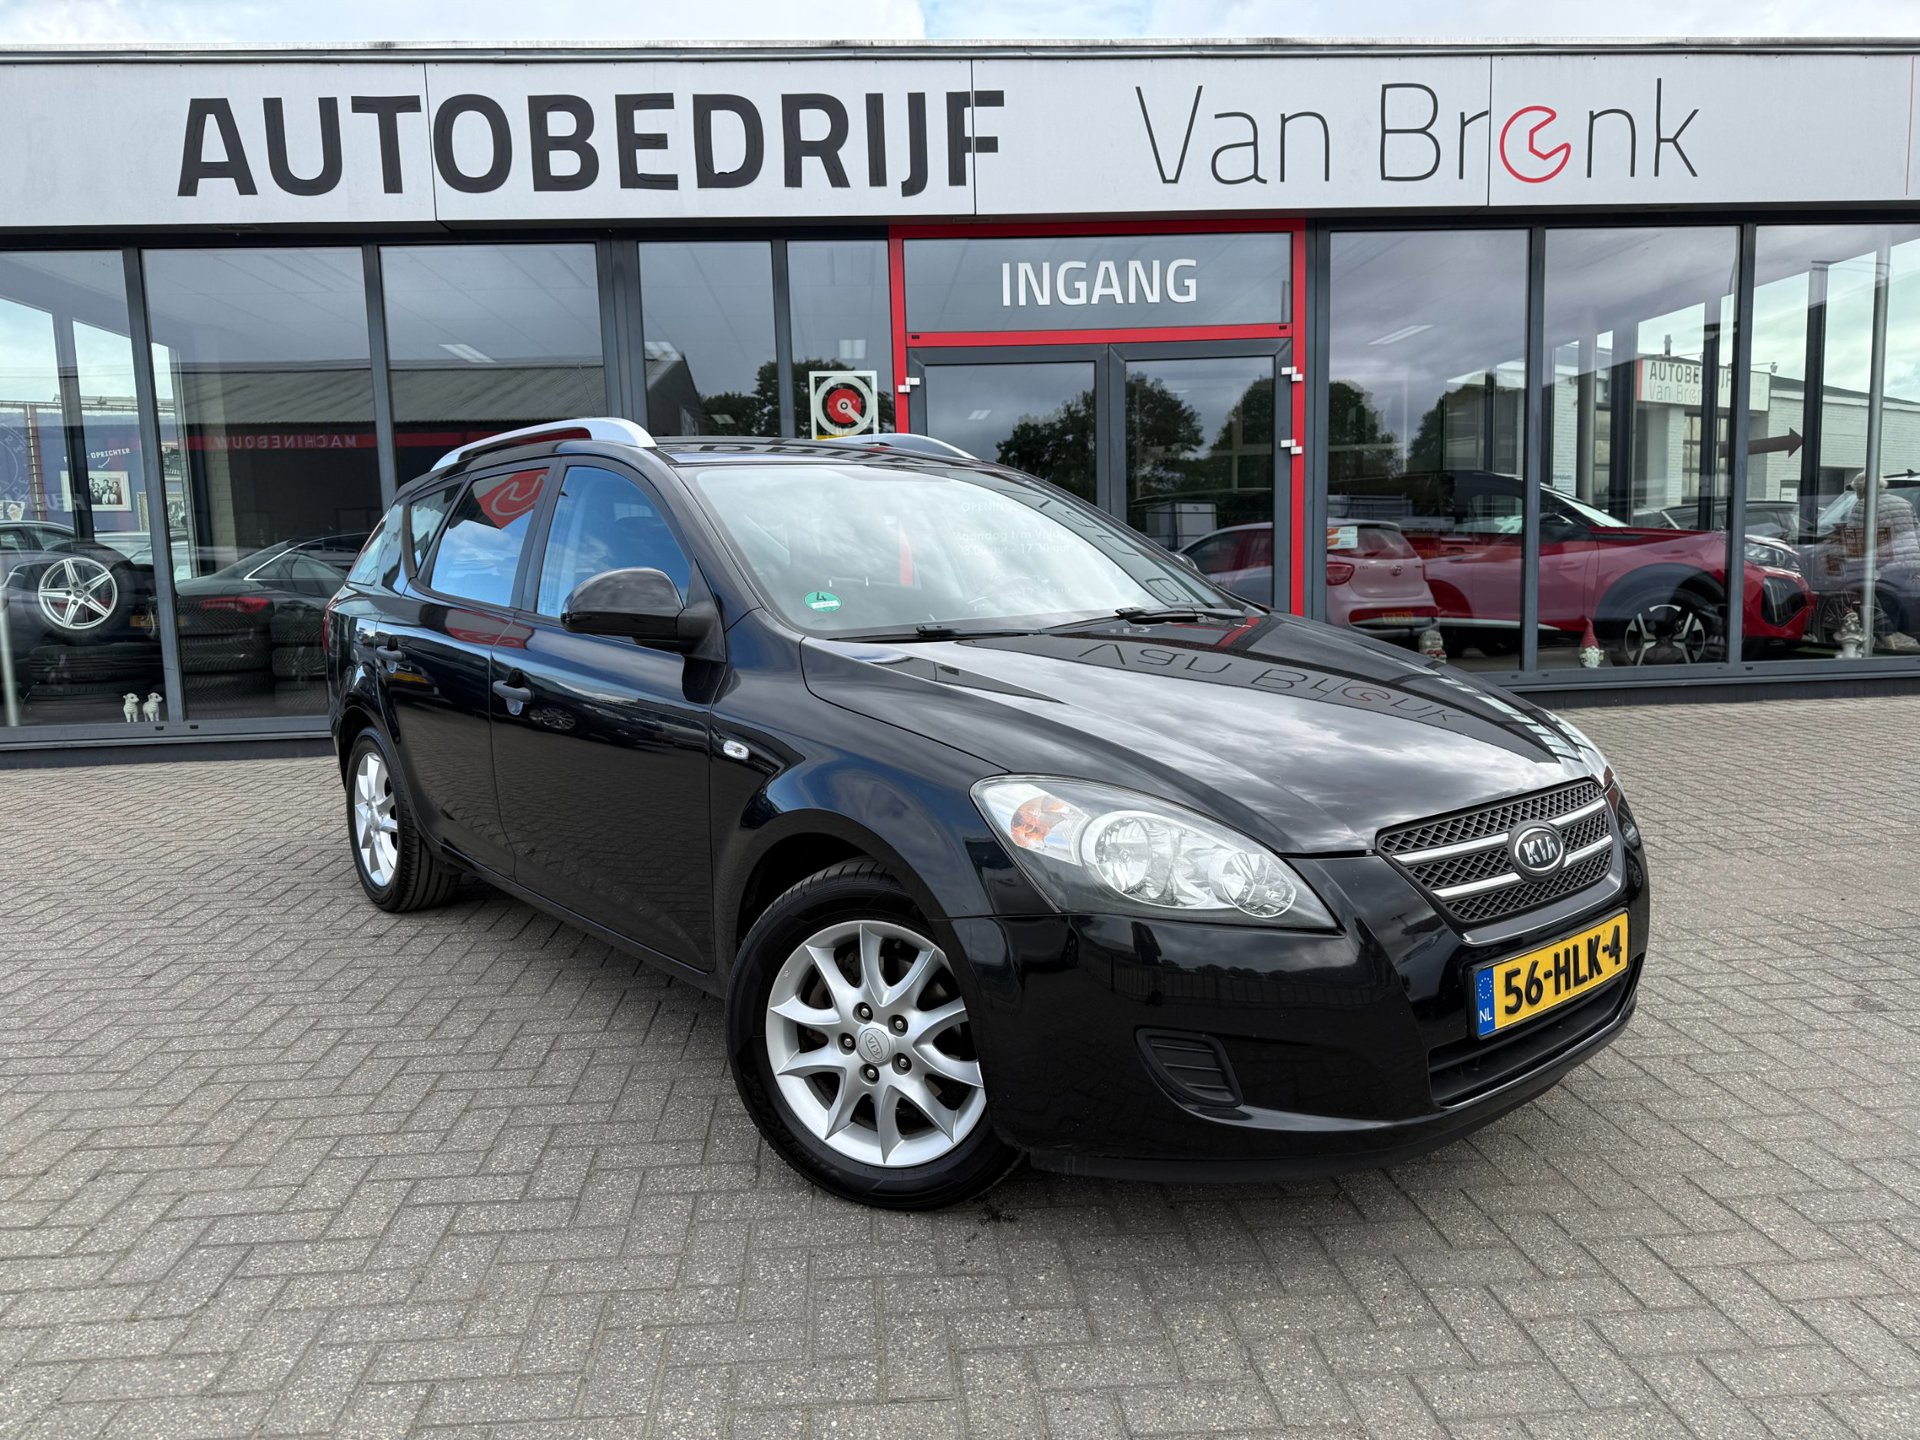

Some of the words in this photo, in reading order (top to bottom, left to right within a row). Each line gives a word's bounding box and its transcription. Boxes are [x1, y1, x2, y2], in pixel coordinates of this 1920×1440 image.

[177, 90, 1004, 196] AUTOBEDRIJF
[1135, 85, 1329, 184] Van
[1380, 78, 1700, 183] Bronk
[1001, 259, 1198, 307] INGANG
[1522, 836, 1558, 865] KIA
[1504, 924, 1623, 1015] 56-HLK-4
[1479, 1007, 1493, 1024] NL
[867, 1036, 881, 1056] KIA
